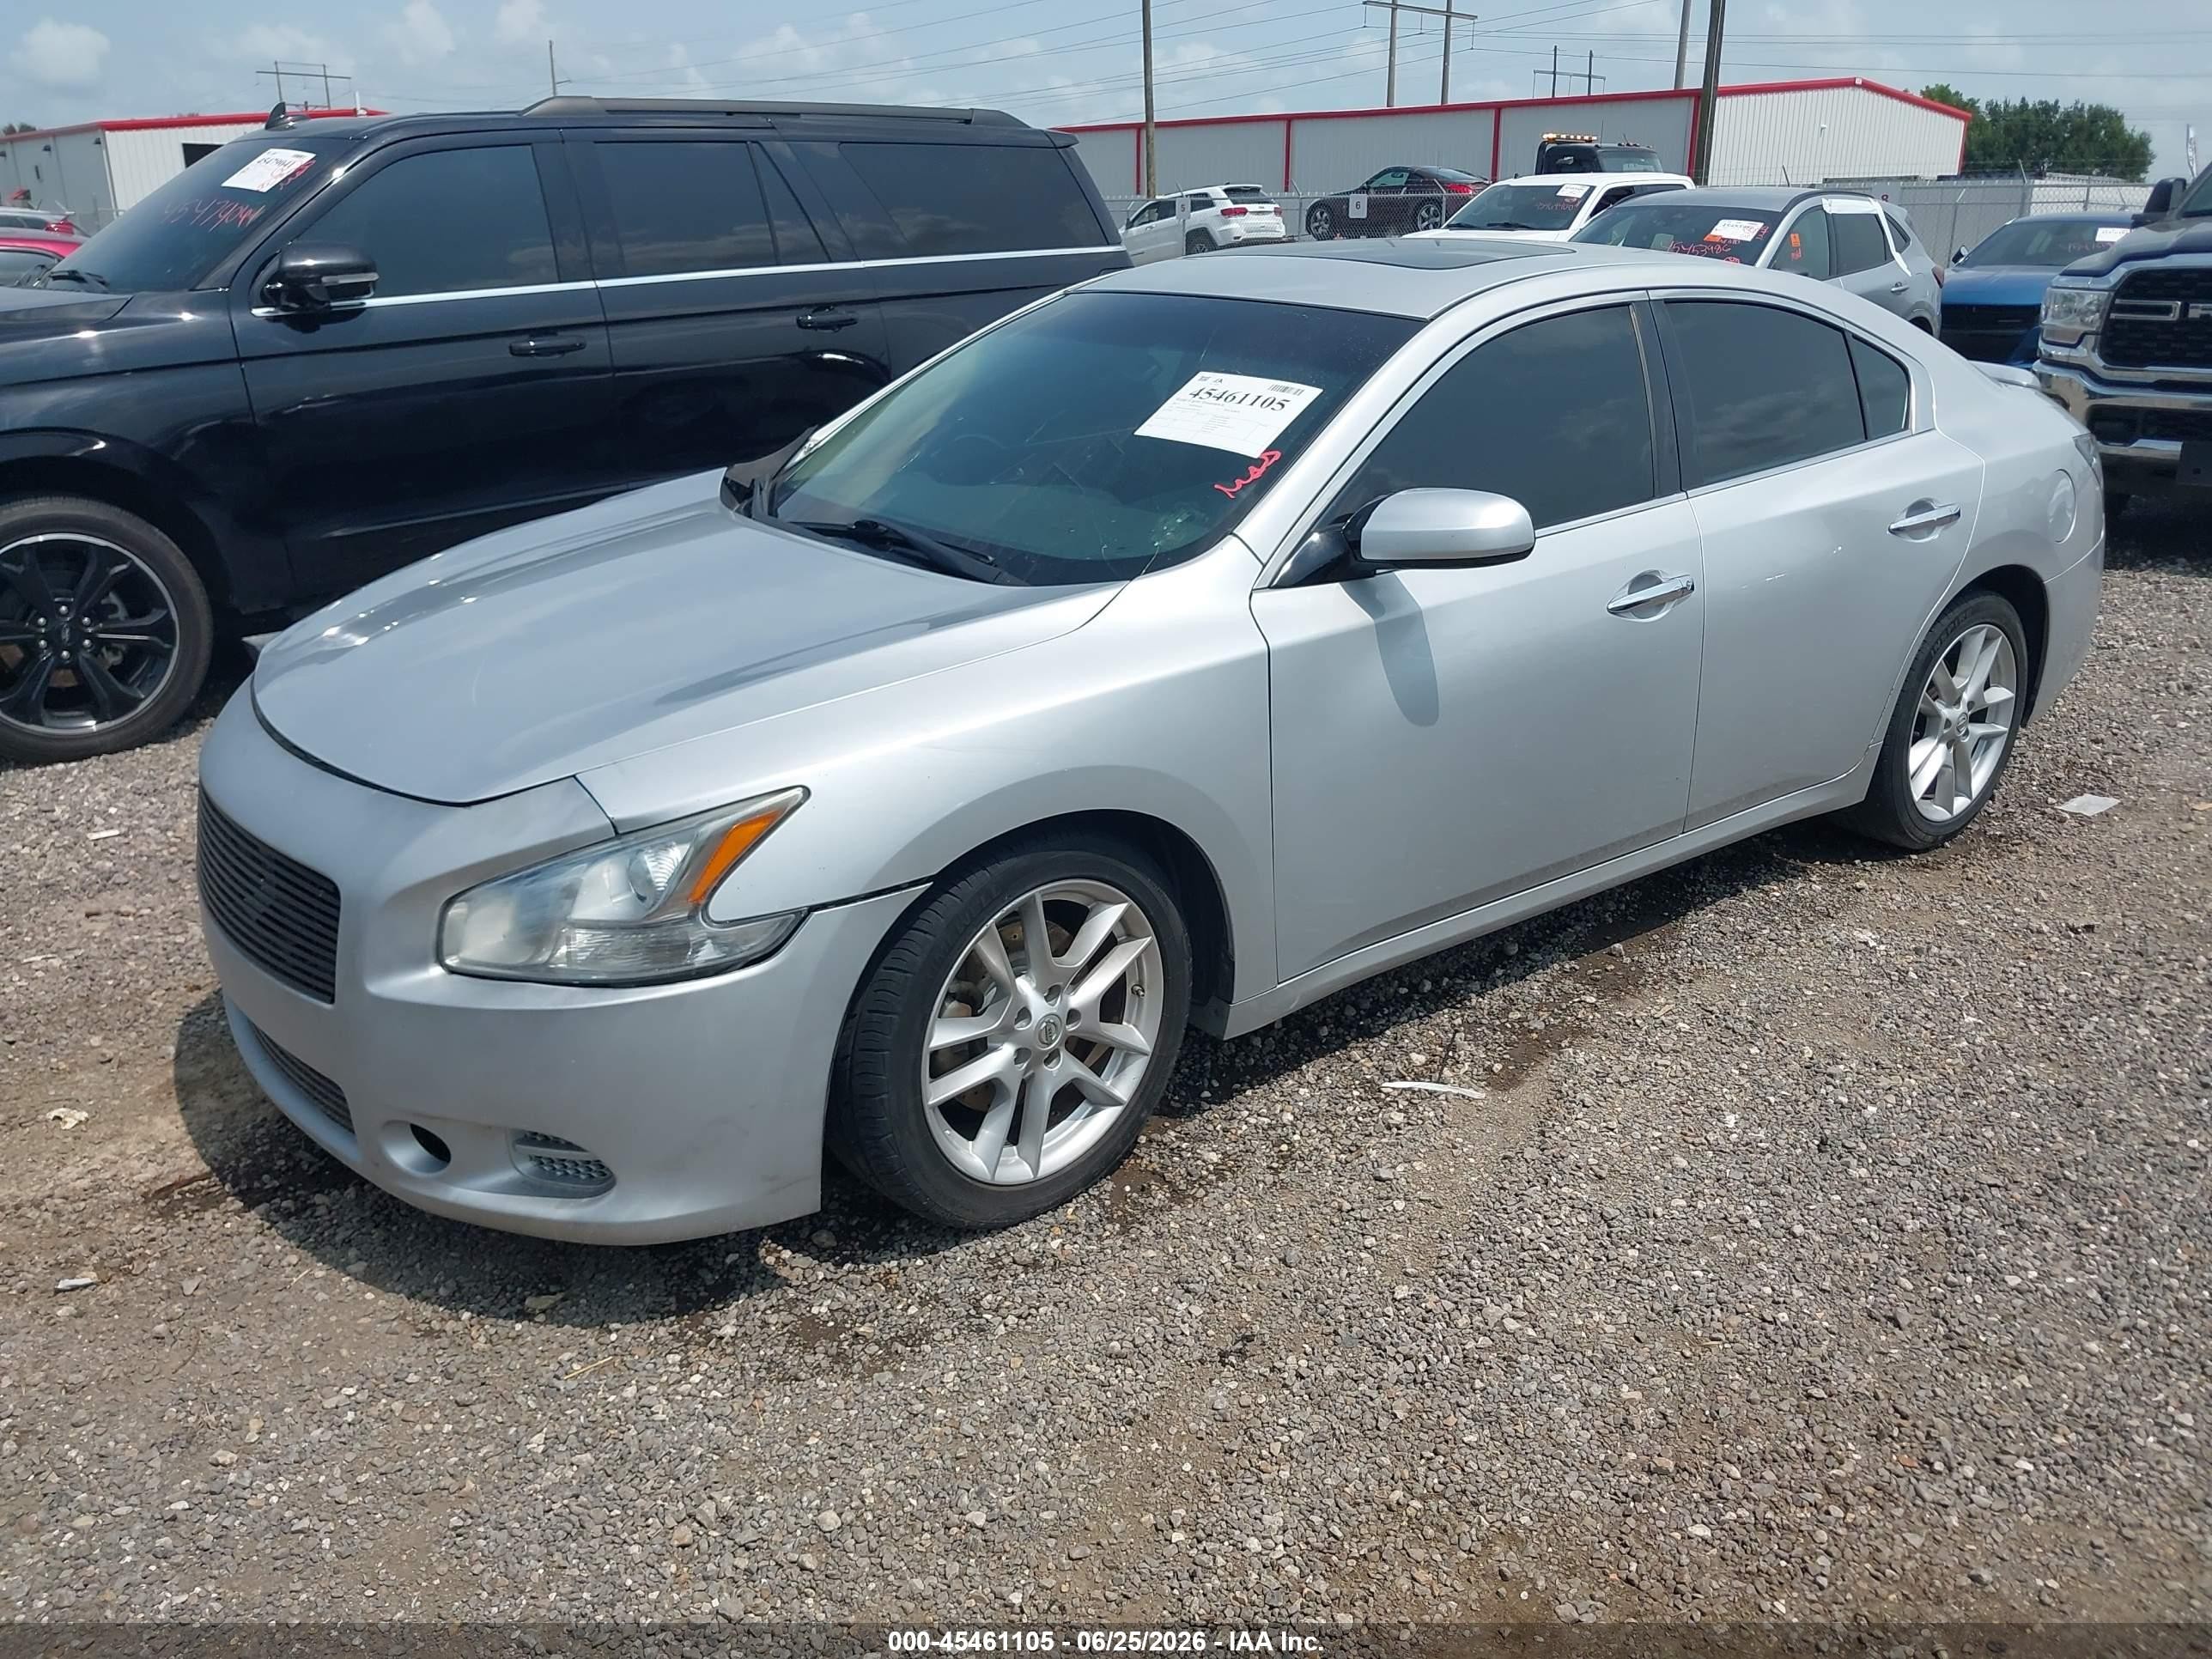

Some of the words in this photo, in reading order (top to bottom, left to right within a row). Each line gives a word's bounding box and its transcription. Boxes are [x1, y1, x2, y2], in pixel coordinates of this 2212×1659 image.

[1181, 204, 1186, 212] 5
[1355, 200, 1361, 210] 6
[1188, 386, 1291, 411] 45461105
